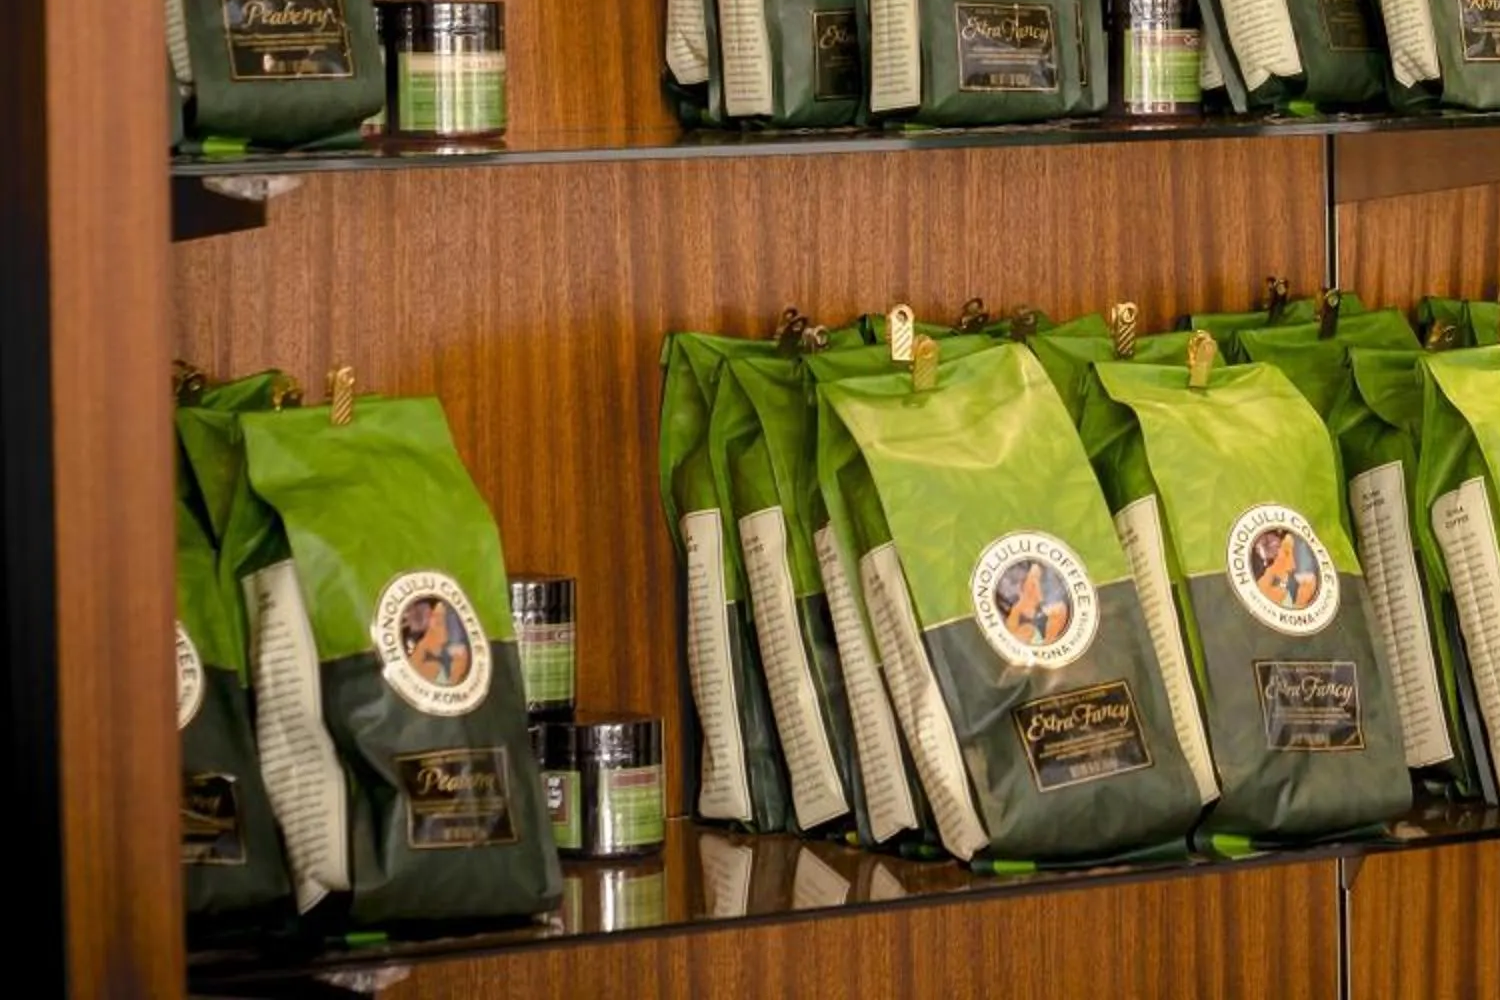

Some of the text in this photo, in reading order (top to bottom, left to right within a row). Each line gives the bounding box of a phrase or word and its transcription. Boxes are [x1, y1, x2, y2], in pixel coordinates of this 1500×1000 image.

[241, 0, 330, 31] Peaberry
[1231, 510, 1335, 587] HONOLULU COFFEE
[976, 538, 1091, 628] HONOLULU COFFEE
[380, 576, 435, 663] HONOLULU
[1278, 612, 1314, 626] KONA
[1300, 675, 1353, 706] Fancy
[1026, 702, 1130, 741] Extra Fancy
